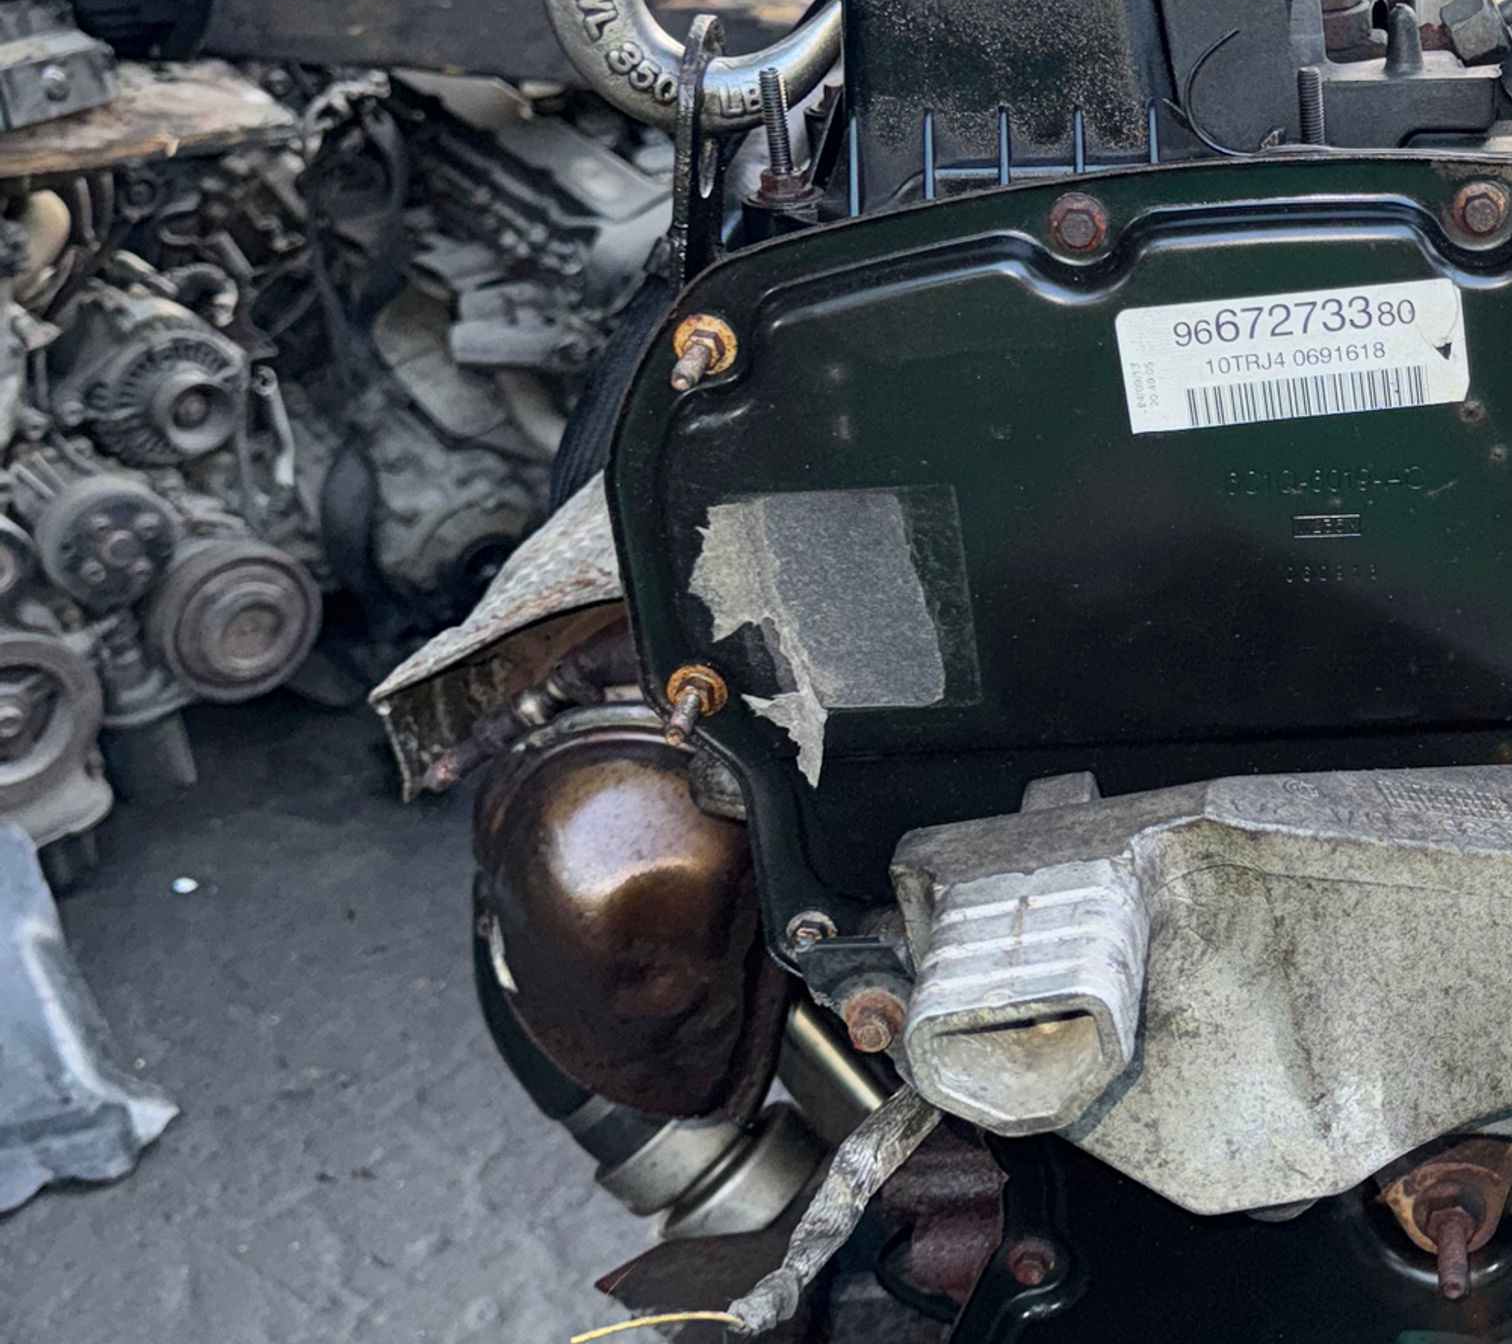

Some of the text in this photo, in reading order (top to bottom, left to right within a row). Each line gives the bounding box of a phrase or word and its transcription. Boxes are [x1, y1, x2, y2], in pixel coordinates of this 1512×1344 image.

[1173, 296, 1416, 347] 9667273380
[1205, 342, 1386, 375] 10TRJ4 0691618
